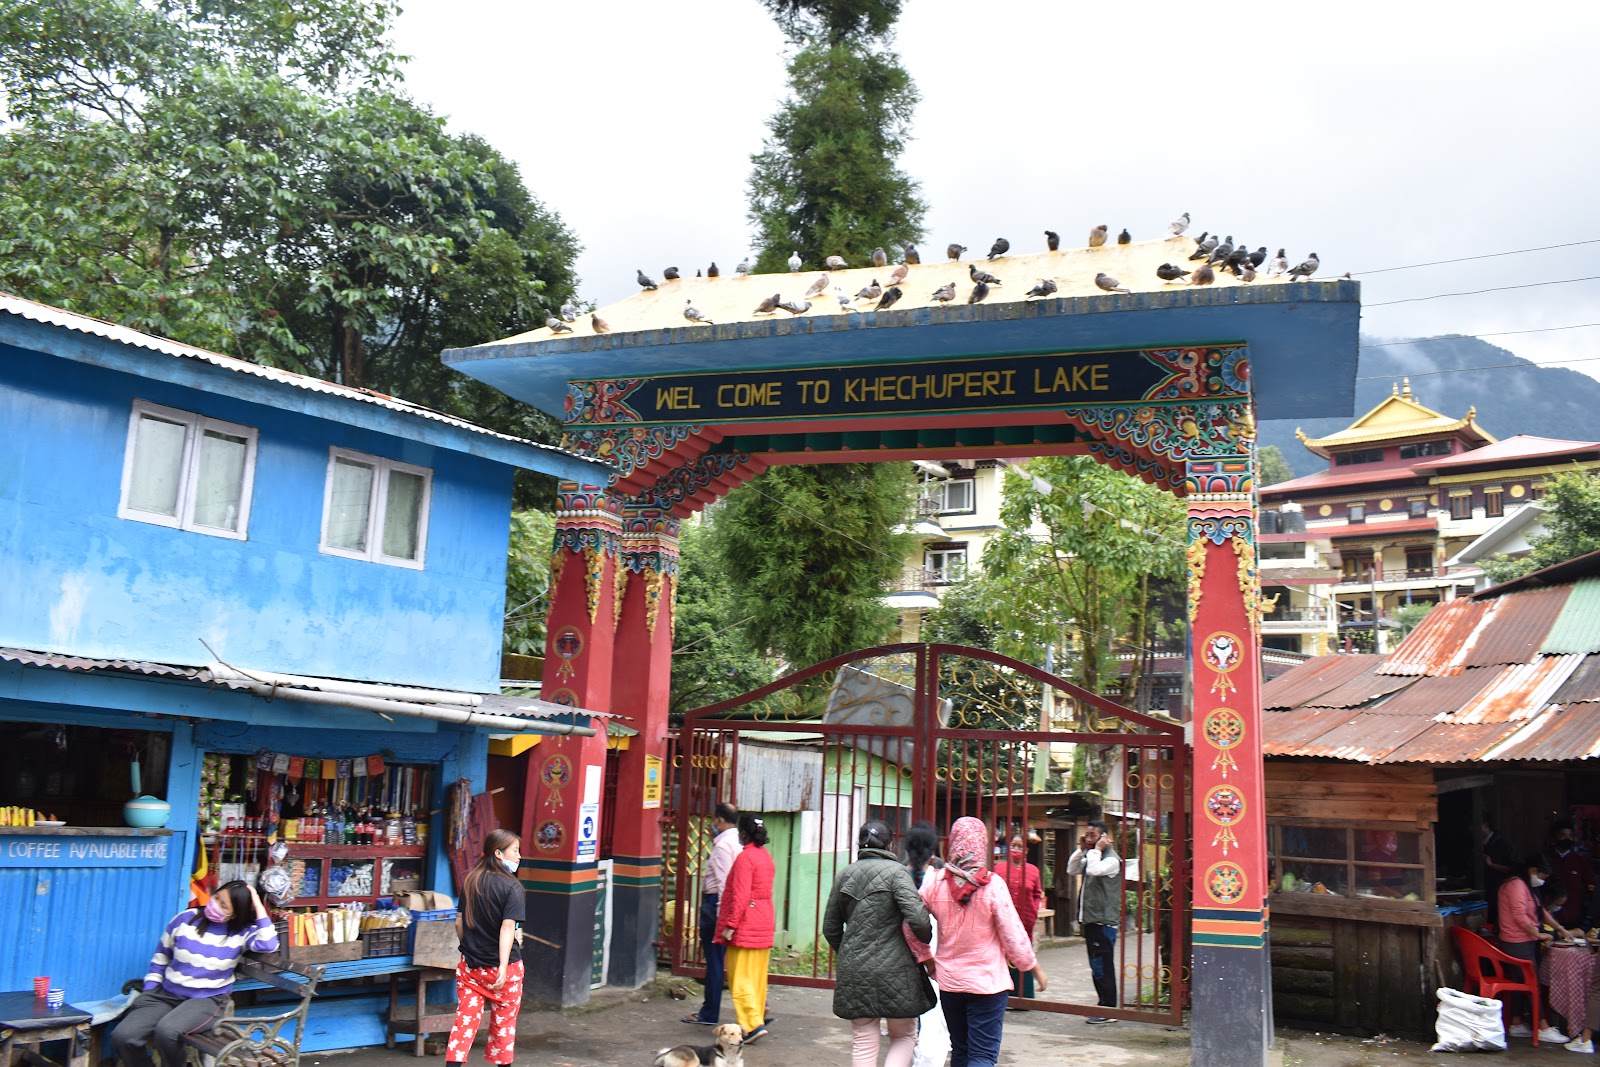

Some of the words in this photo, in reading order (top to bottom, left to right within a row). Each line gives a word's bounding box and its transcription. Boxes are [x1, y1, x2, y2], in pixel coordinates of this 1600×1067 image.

[655, 386, 701, 411] WEL
[717, 382, 783, 408] COME
[797, 380, 831, 404] TO
[844, 369, 1016, 402] KHECHUPERI
[1034, 364, 1109, 394] LAKE
[8, 842, 61, 858] COFFEE
[69, 842, 138, 859] AVAILABLE
[140, 843, 168, 859] HERE
